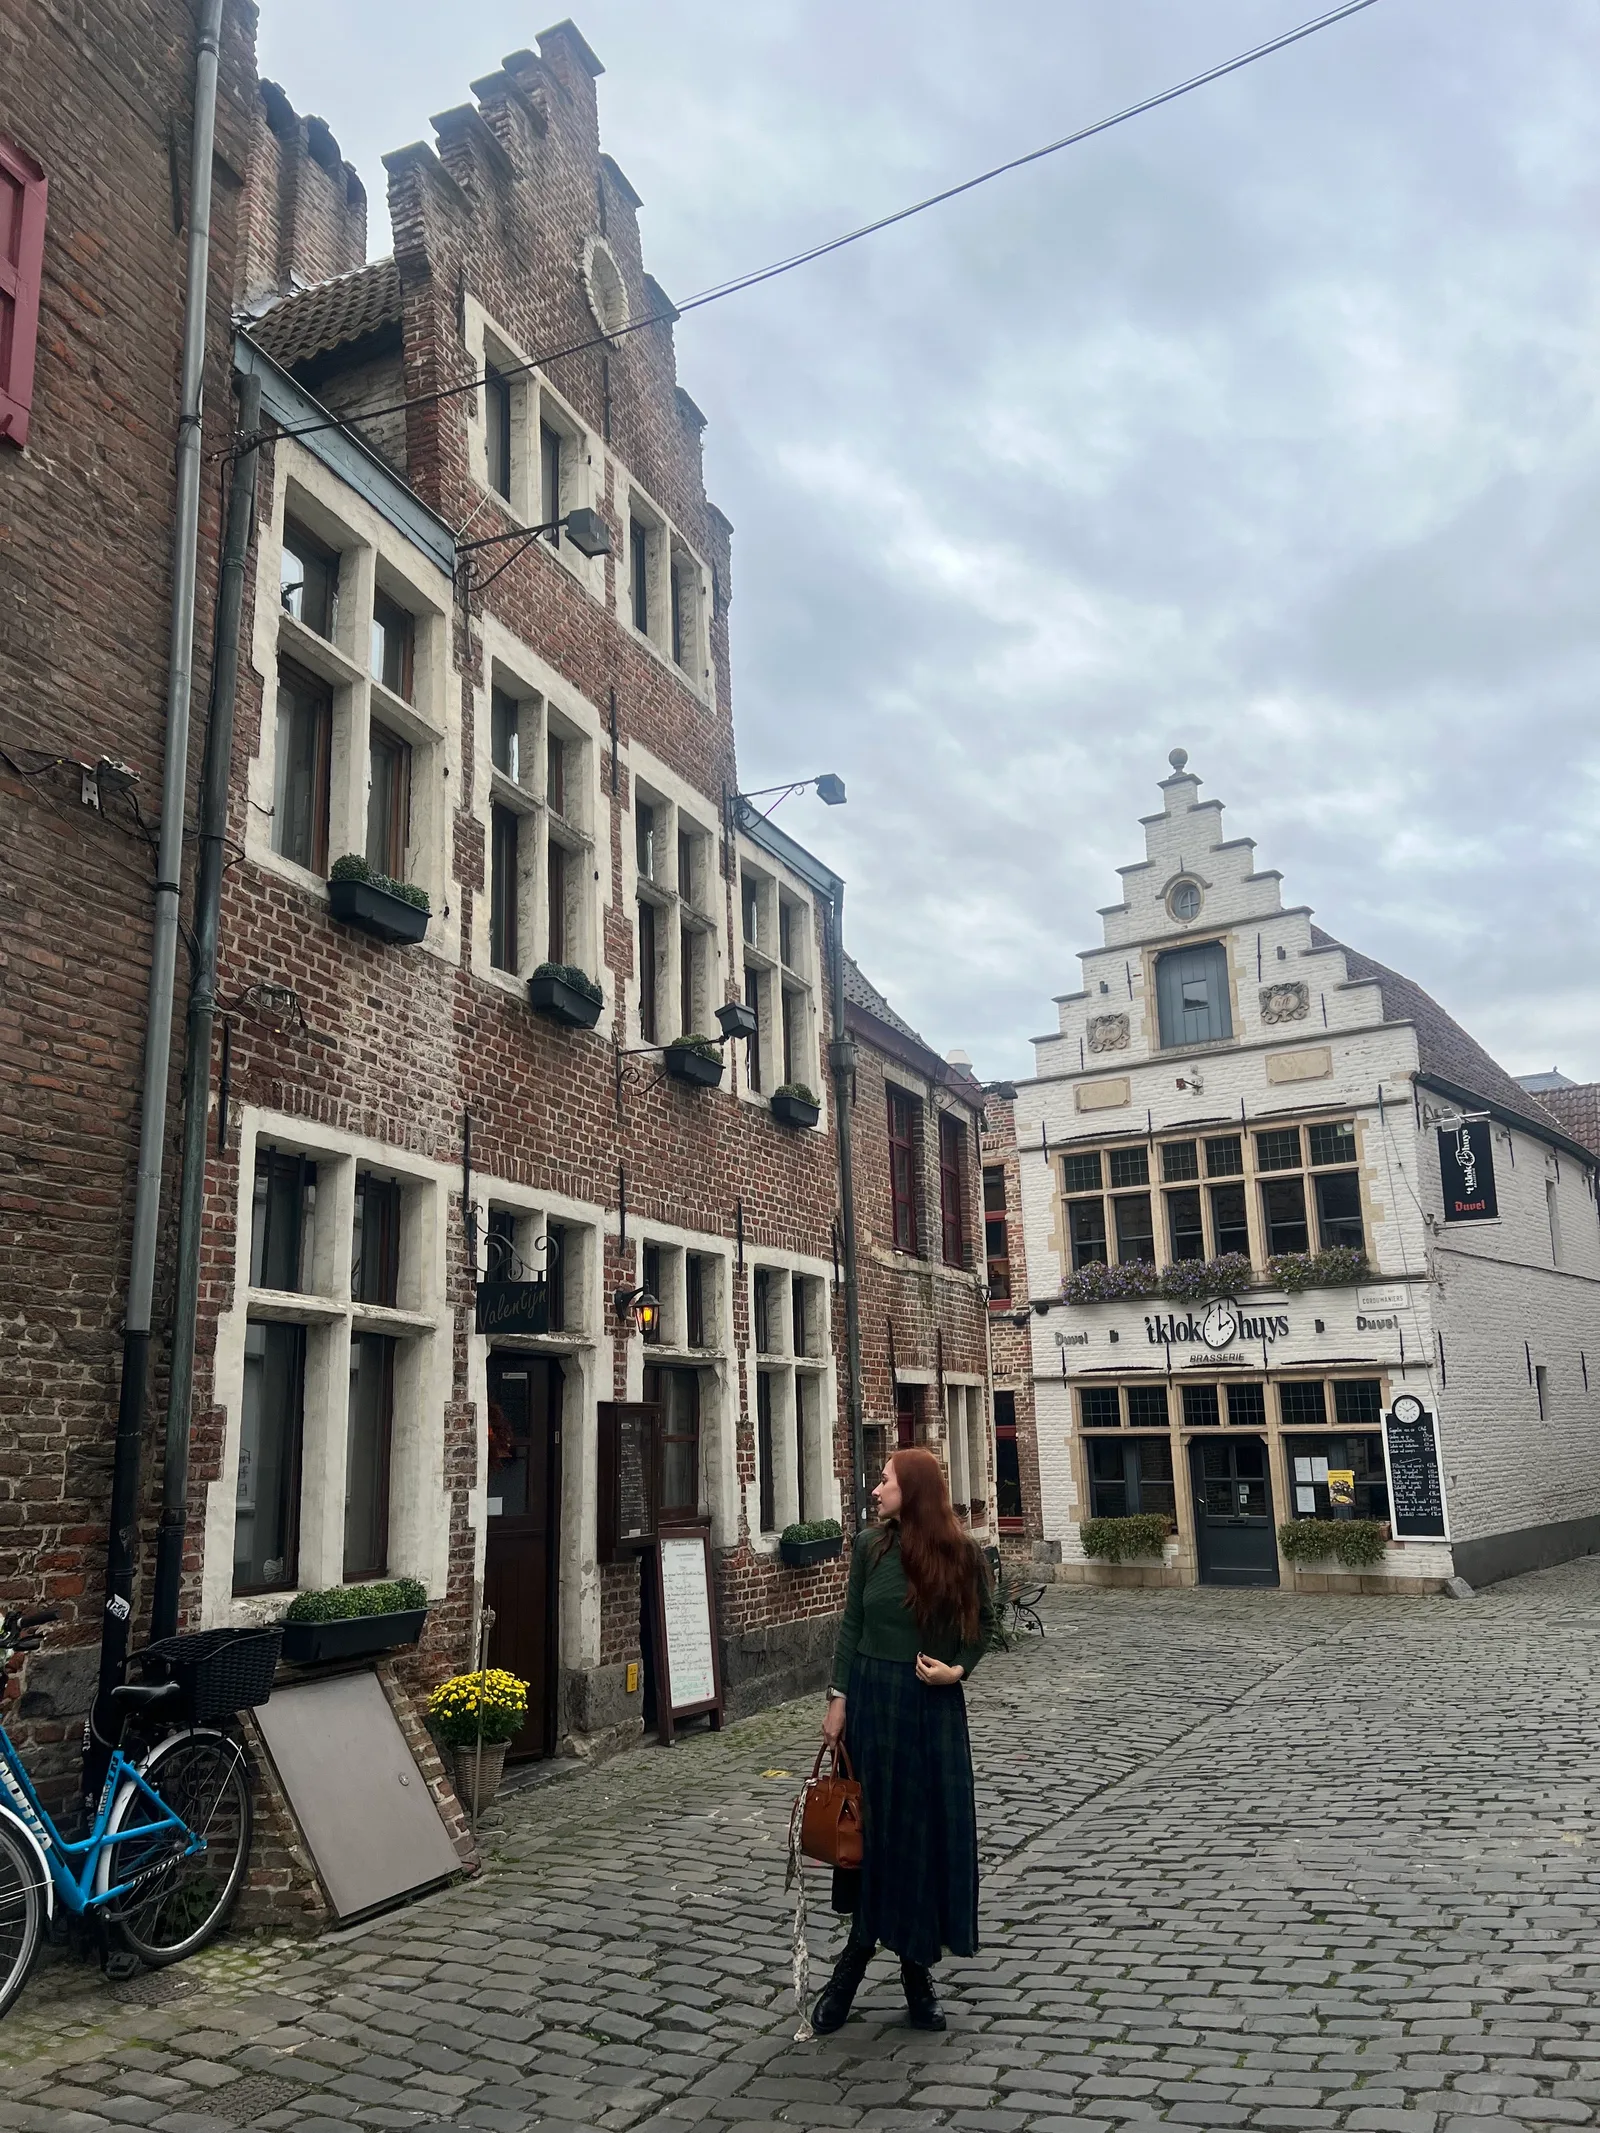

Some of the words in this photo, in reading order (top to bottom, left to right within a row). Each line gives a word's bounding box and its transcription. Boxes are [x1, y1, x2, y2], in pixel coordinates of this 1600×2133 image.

[1461, 1129, 1471, 1151] huys
[1455, 1199, 1486, 1212] Duvel
[478, 1284, 547, 1331] Valentijn
[1236, 1311, 1290, 1343] huys
[1356, 1314, 1399, 1331] Duvel
[1054, 1331, 1088, 1346] Duvel
[1189, 1352, 1245, 1363] BRASSERIE
[0, 1760, 52, 1851] NORTA
